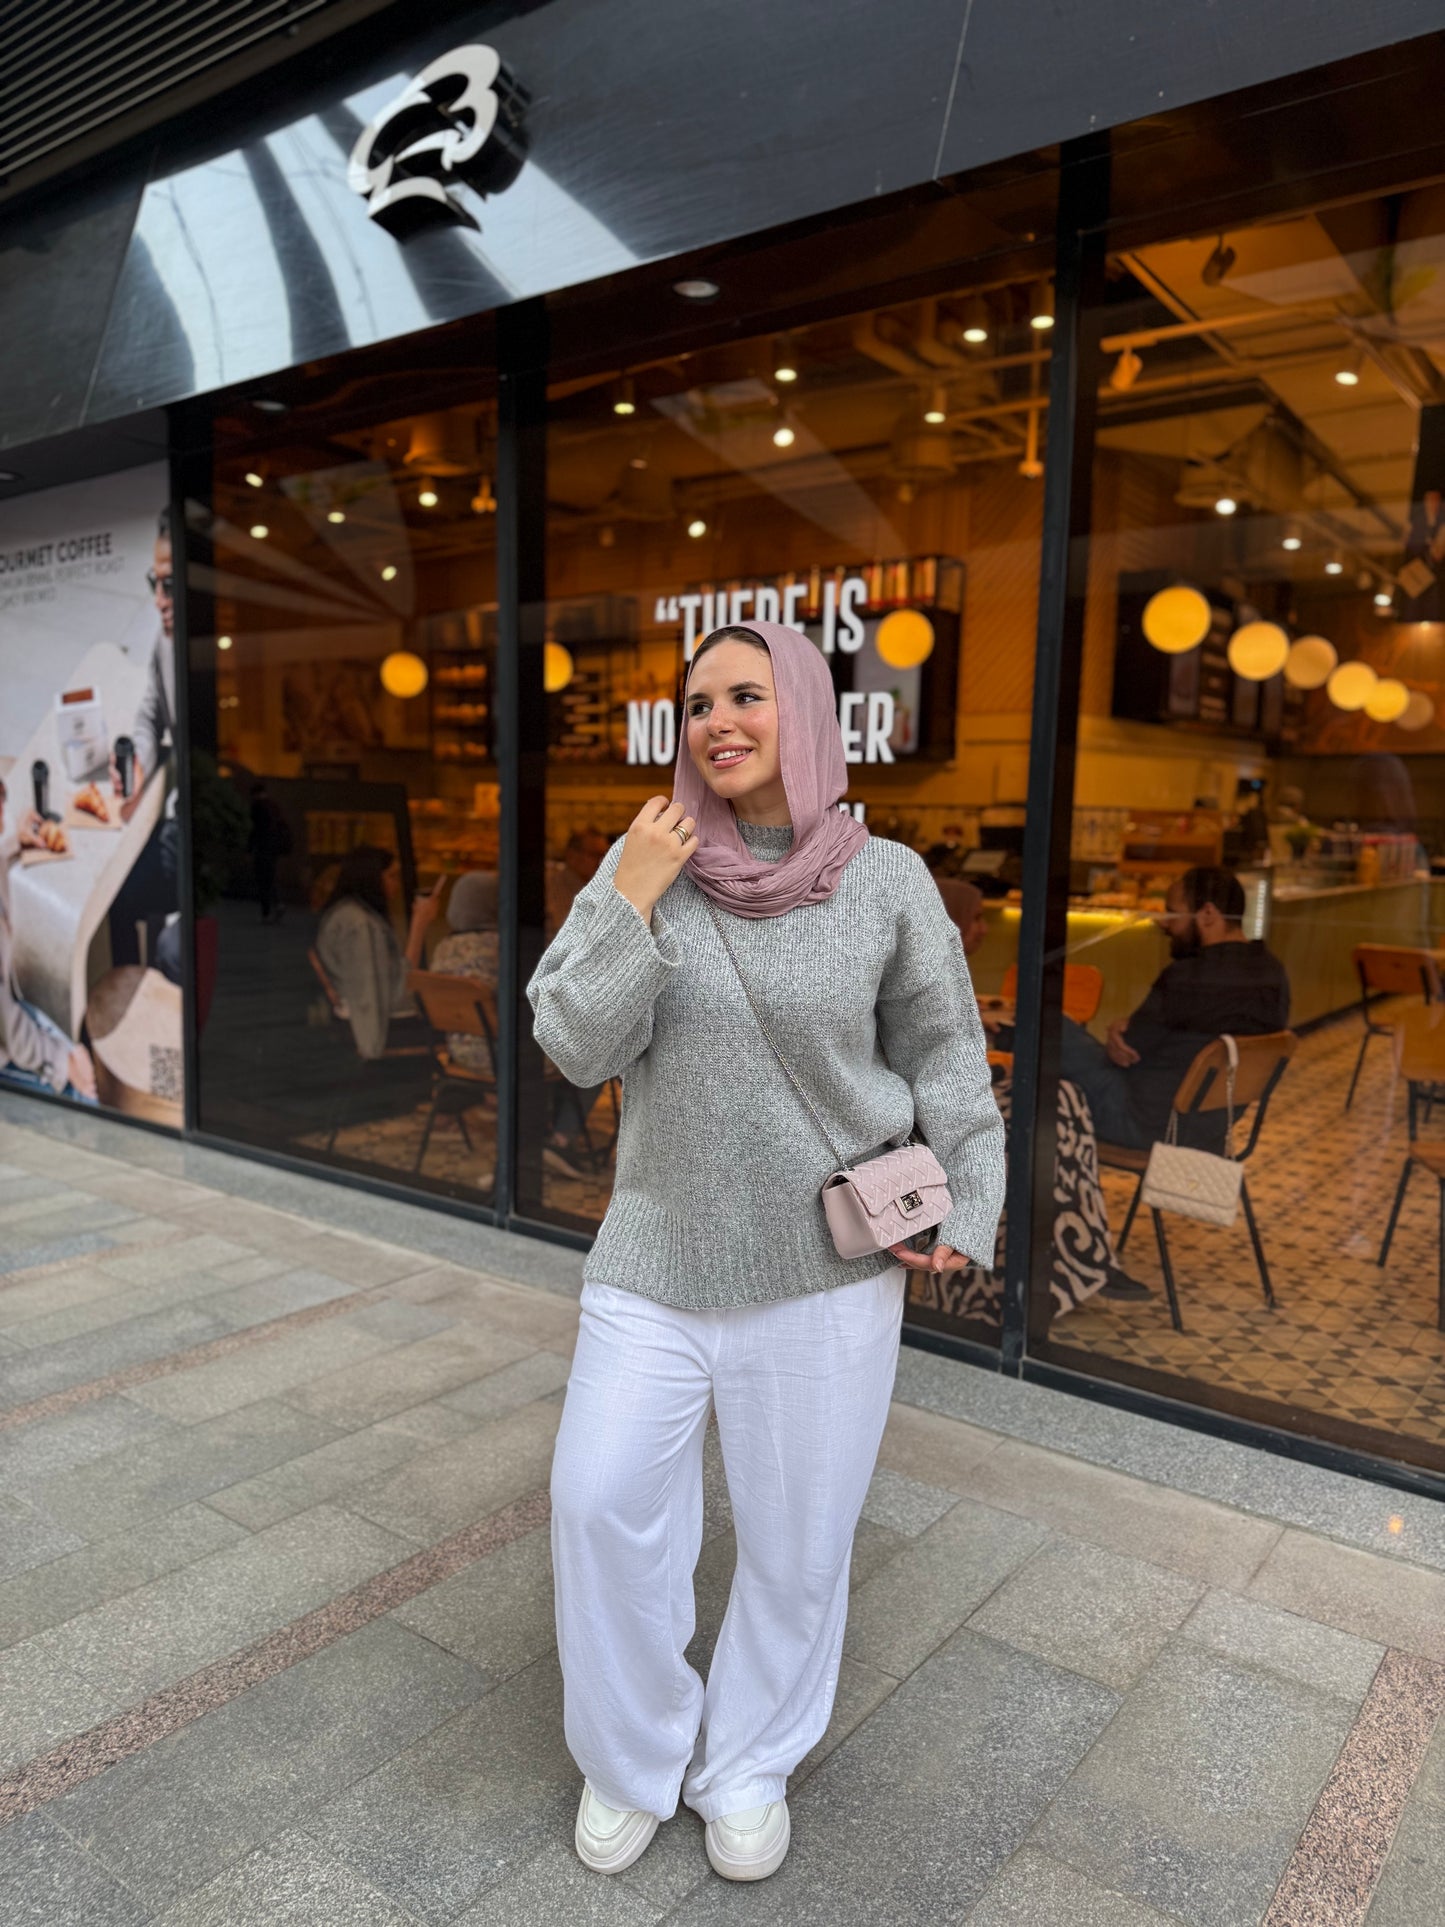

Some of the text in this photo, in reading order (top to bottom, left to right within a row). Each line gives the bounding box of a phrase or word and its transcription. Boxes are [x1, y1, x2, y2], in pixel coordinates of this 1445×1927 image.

[56, 532, 112, 563] COFFEE
[823, 577, 867, 654] IS
[626, 698, 676, 766] NO
